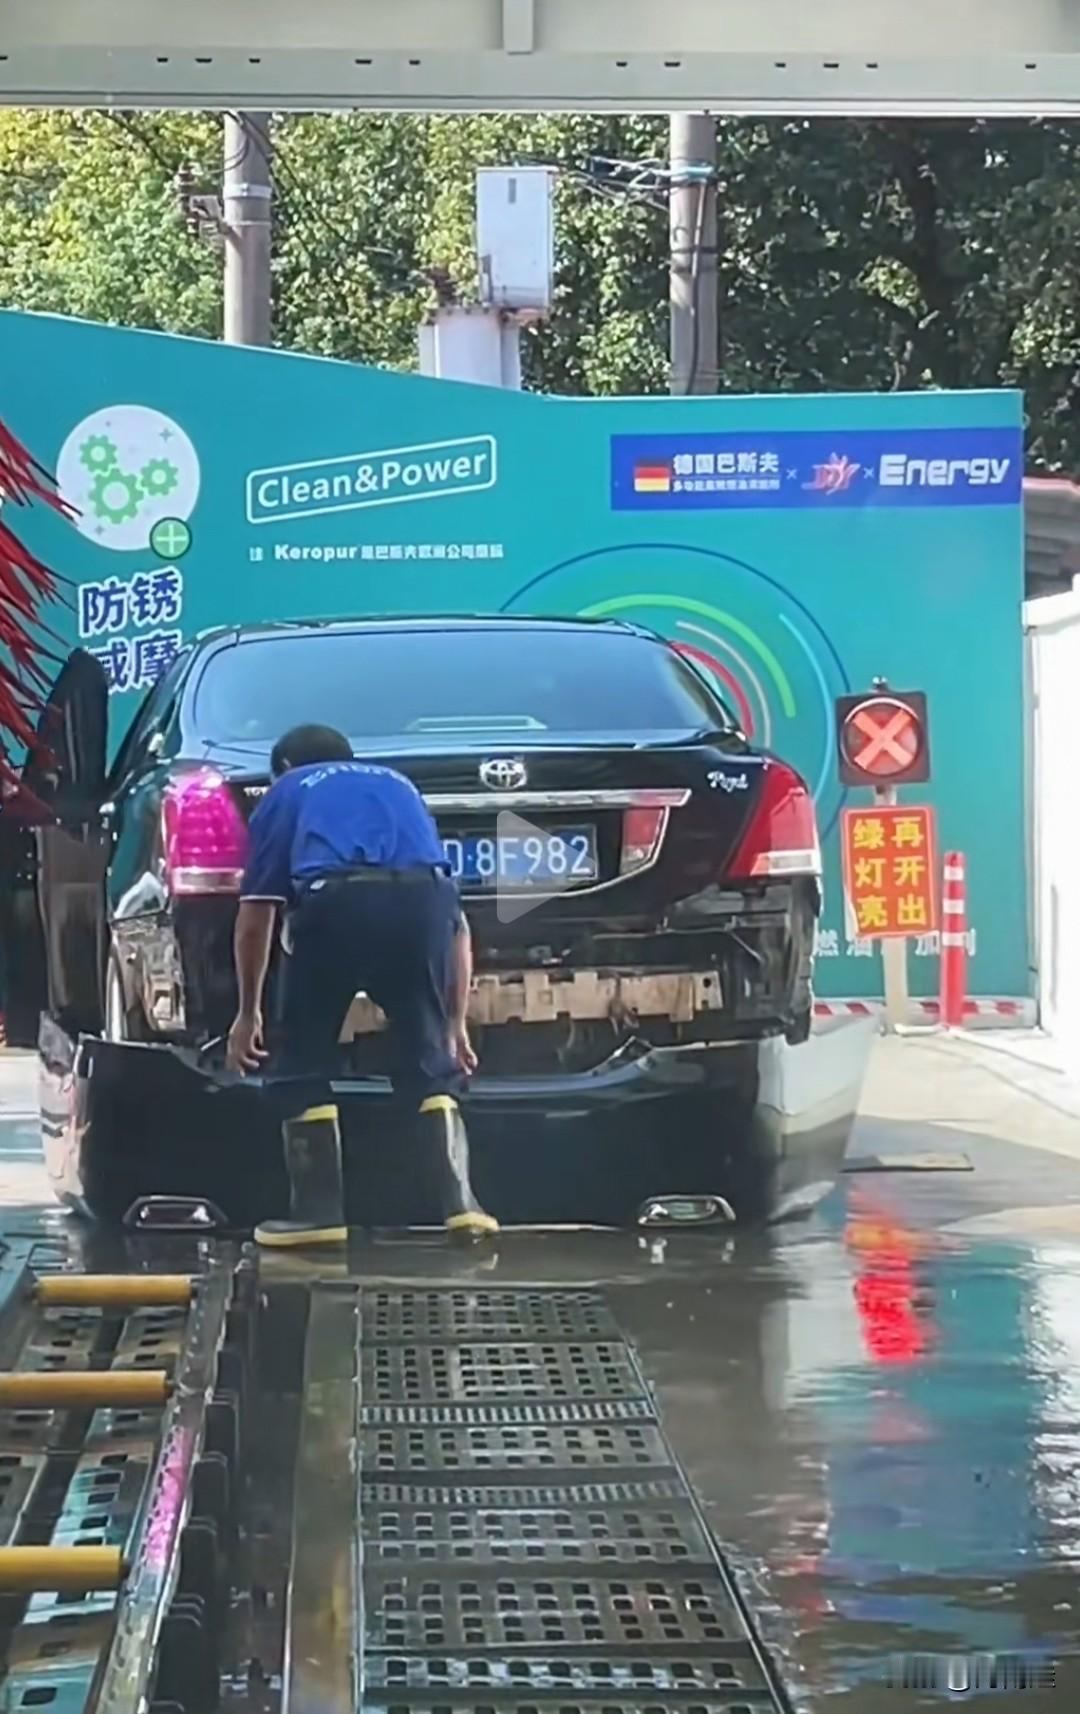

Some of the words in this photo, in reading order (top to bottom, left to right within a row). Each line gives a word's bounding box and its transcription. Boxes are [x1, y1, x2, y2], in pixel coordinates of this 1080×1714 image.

[257, 452, 488, 508] Clean&Power
[673, 452, 779, 475] 德国巴斯夫
[879, 453, 1010, 486] Energy
[274, 543, 358, 562] Keropur
[79, 565, 182, 638] 防锈
[853, 818, 888, 928] 绿灯亮
[891, 816, 927, 925] 再开出
